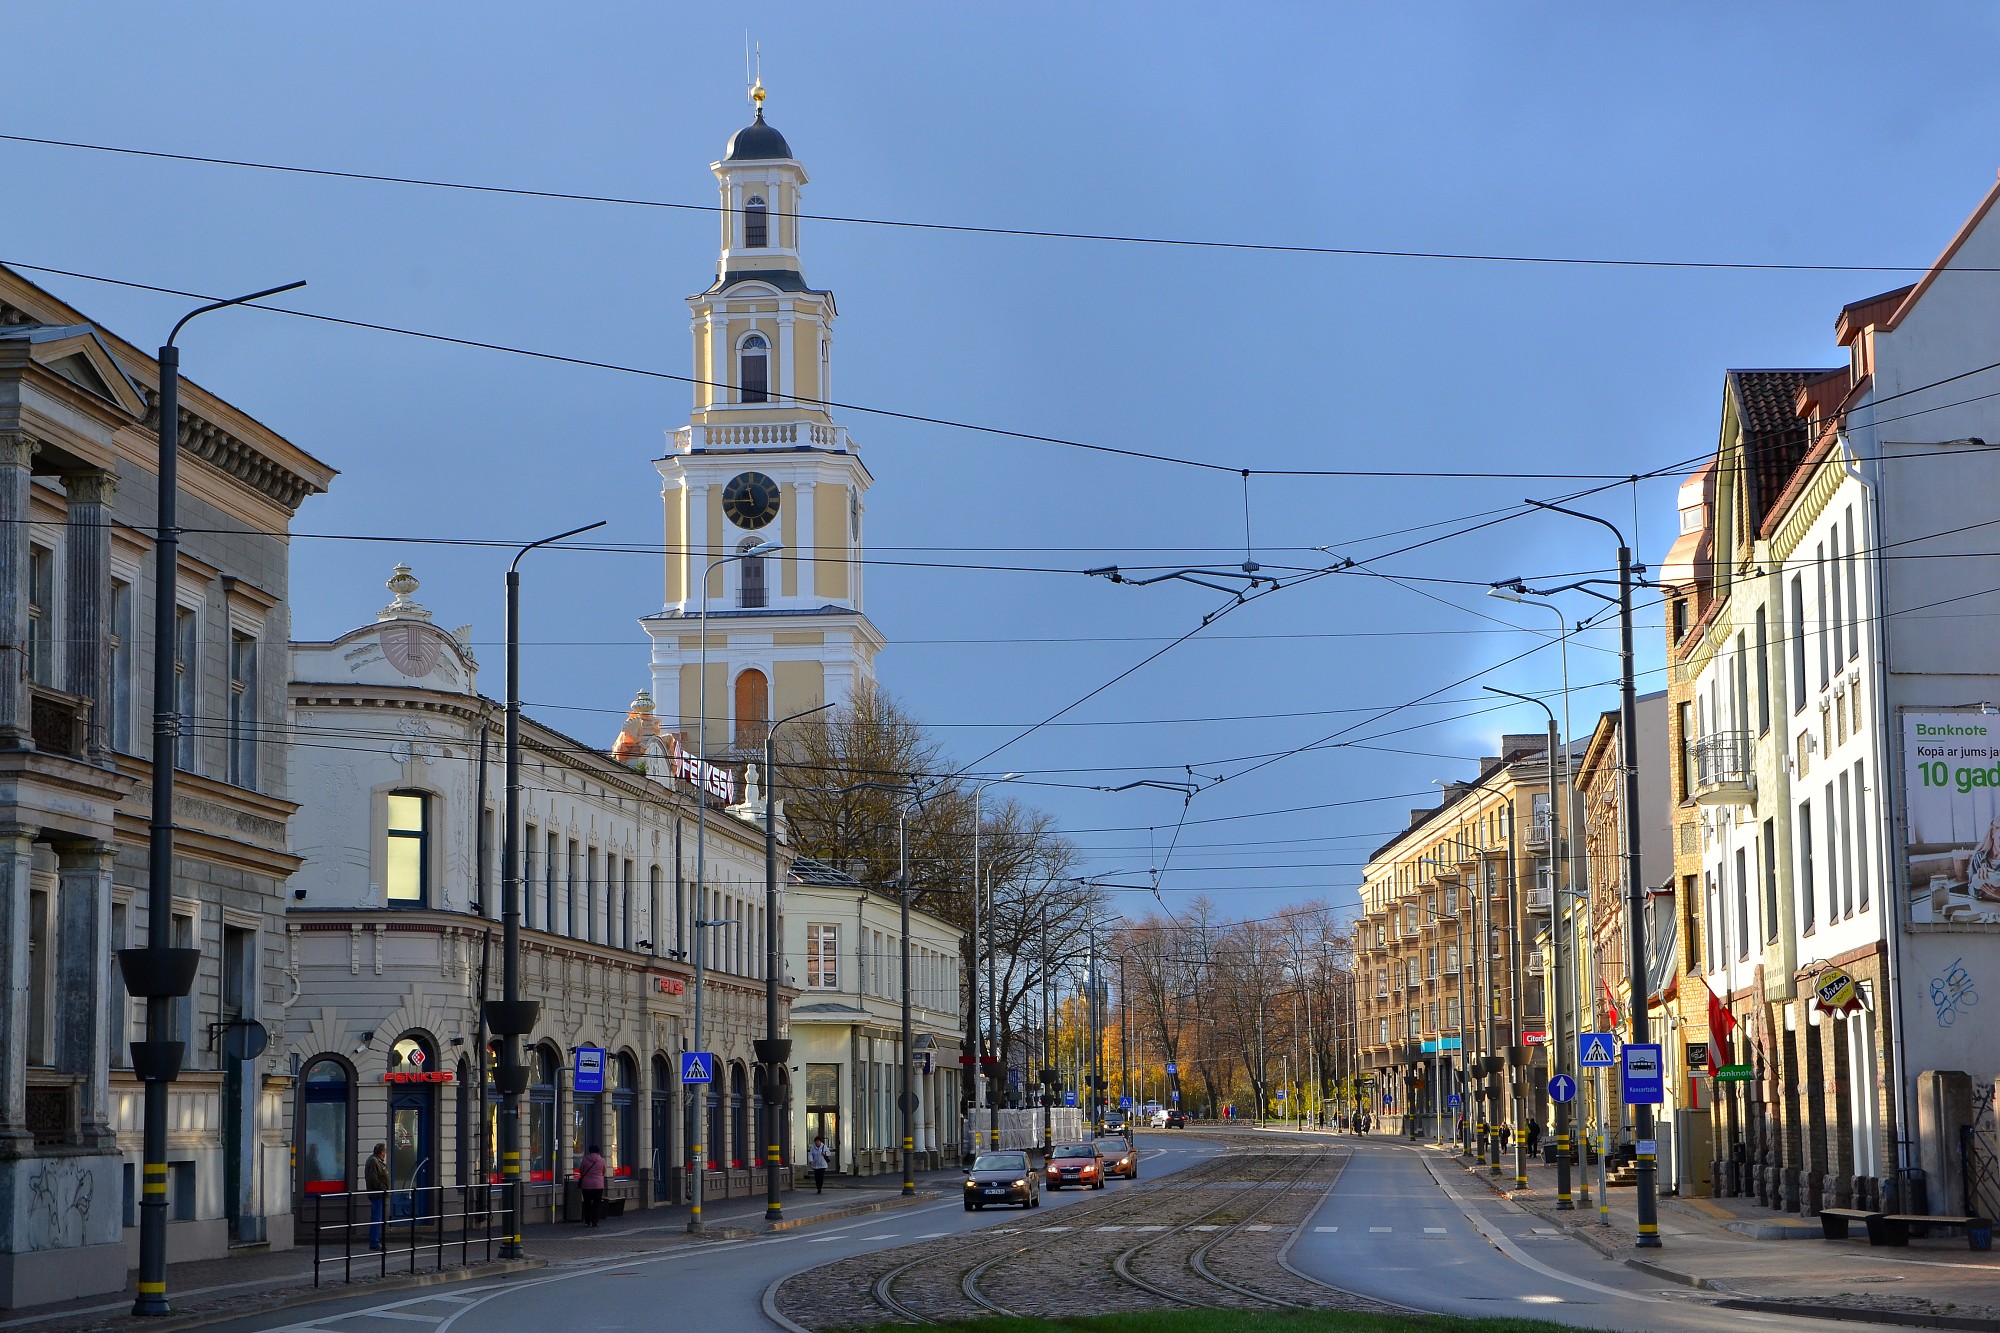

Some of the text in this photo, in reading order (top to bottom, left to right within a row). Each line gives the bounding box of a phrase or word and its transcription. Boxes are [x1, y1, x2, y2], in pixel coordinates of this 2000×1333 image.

[1916, 724, 1987, 736] Banknote
[1917, 746, 1944, 758] Kopā
[1947, 749, 1958, 757] ar
[1960, 746, 1987, 758] jums
[1917, 761, 1949, 787] 10
[384, 1071, 454, 1083] FENIKSS
